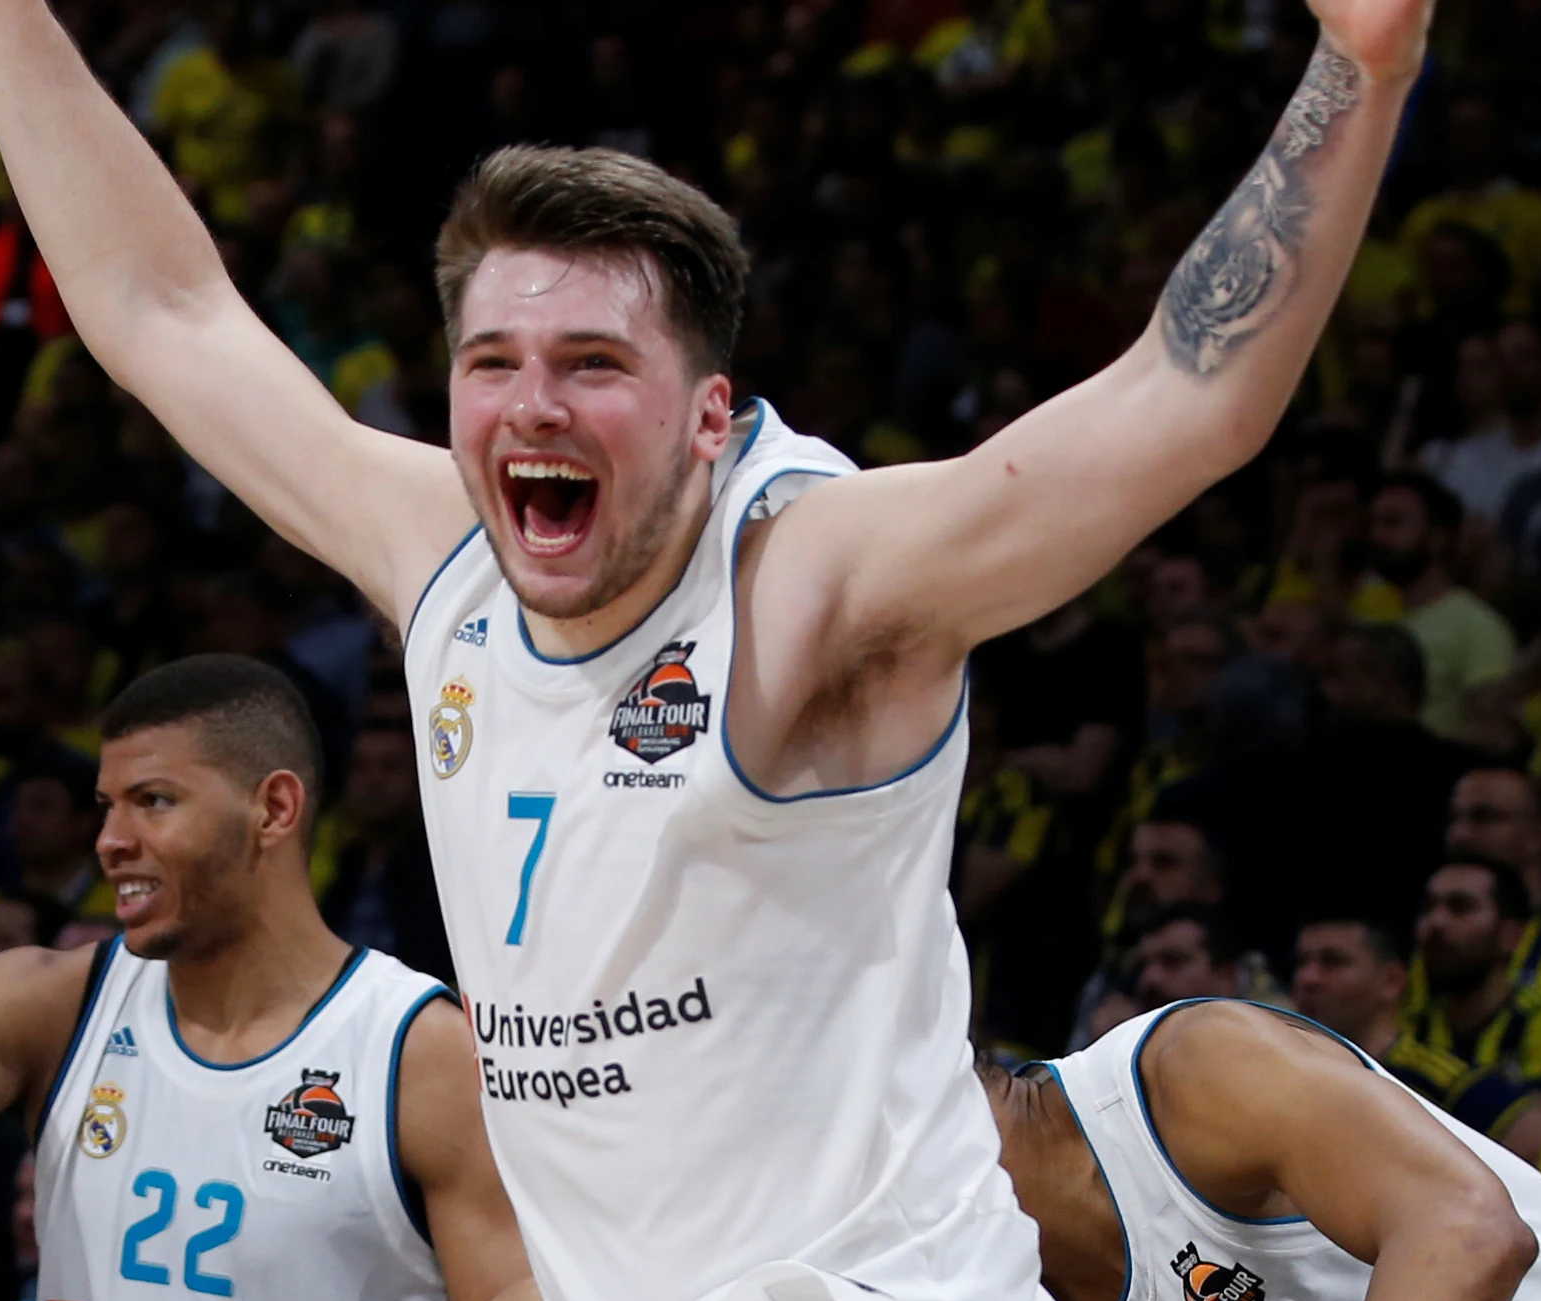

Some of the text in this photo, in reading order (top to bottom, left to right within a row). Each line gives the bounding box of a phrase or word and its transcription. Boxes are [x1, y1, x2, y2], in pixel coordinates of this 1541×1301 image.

[611, 702, 706, 730] FINAL FOUR
[603, 769, 685, 789] oneteam
[506, 791, 557, 946] 7
[475, 976, 714, 1048] Universidad
[481, 1056, 632, 1109] Europea
[267, 1110, 308, 1130] FINAL
[309, 1116, 351, 1139] FOUR
[262, 1159, 332, 1182] oneteam
[120, 1166, 246, 1298] 22
